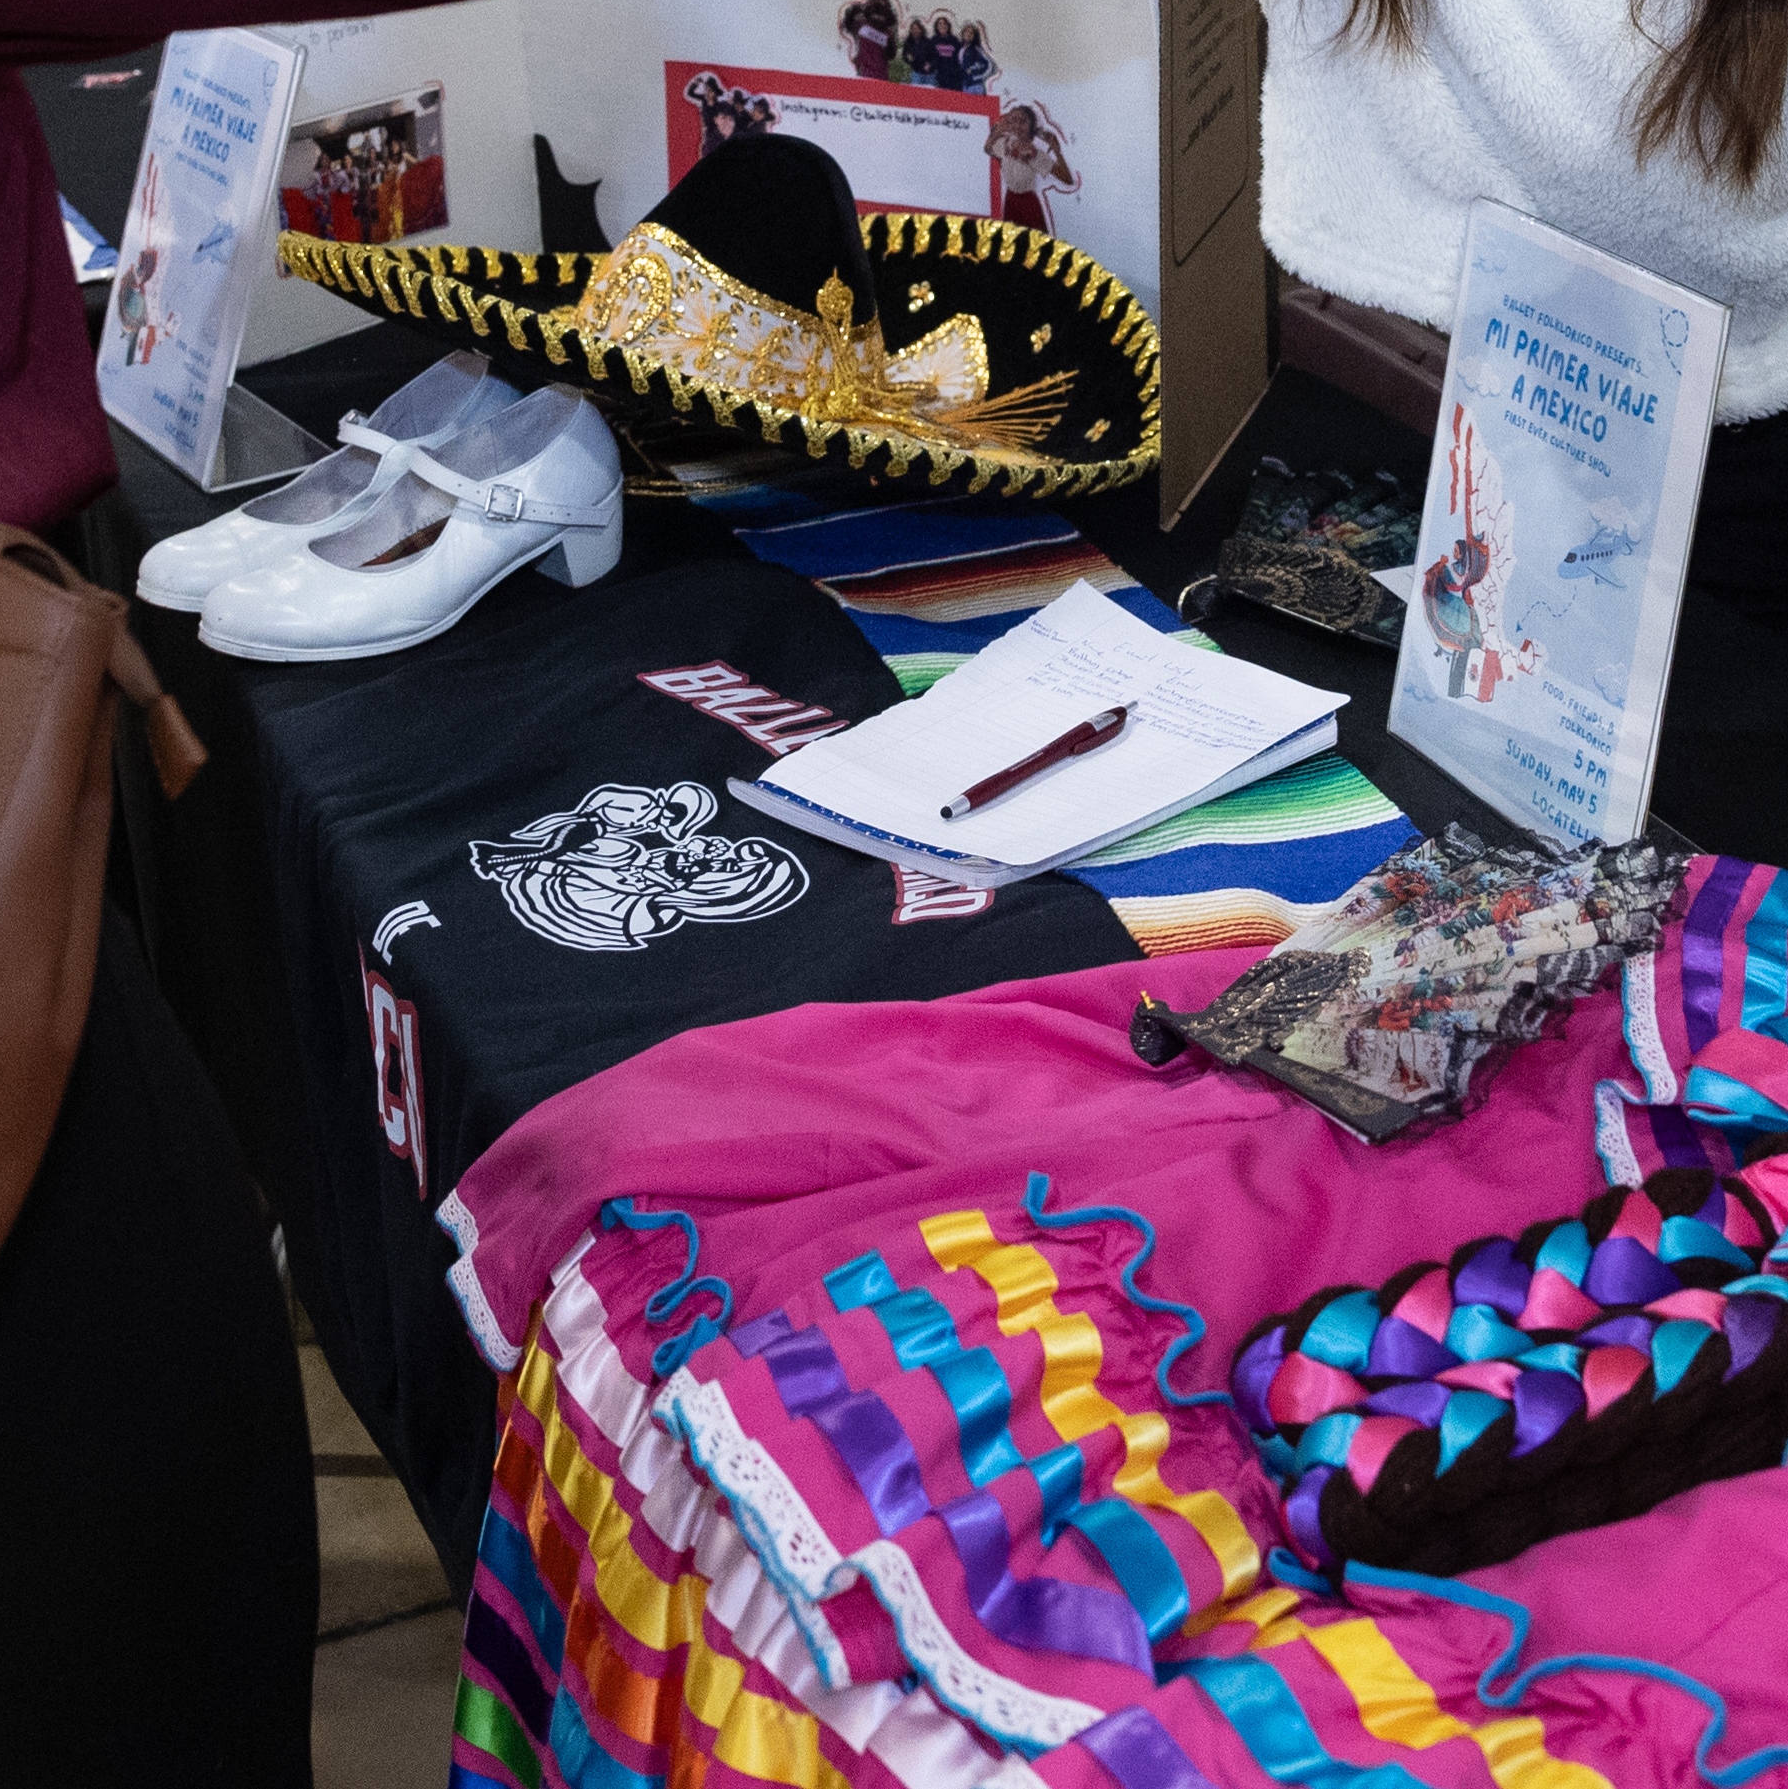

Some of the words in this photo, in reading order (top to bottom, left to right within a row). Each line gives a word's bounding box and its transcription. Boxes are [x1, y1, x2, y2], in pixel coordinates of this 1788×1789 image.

[1503, 294, 1535, 320] BALLET
[1538, 312, 1593, 348] FOLKLORICO
[1485, 317, 1510, 349] MI
[1514, 329, 1590, 393] PRIMER
[1599, 373, 1658, 424] VIAJE
[1512, 374, 1525, 403] A
[1529, 384, 1608, 443] MEXICO
[1504, 410, 1527, 430] FIRST
[1528, 422, 1548, 441] EVER
[1550, 435, 1587, 462] CULTURE
[1589, 455, 1612, 478] SHOW
[1560, 716, 1612, 757] FOLKLORICO
[1573, 749, 1584, 770] 5
[1586, 759, 1607, 788] PM
[1556, 777, 1585, 805] MAY
[1587, 794, 1597, 815] 5
